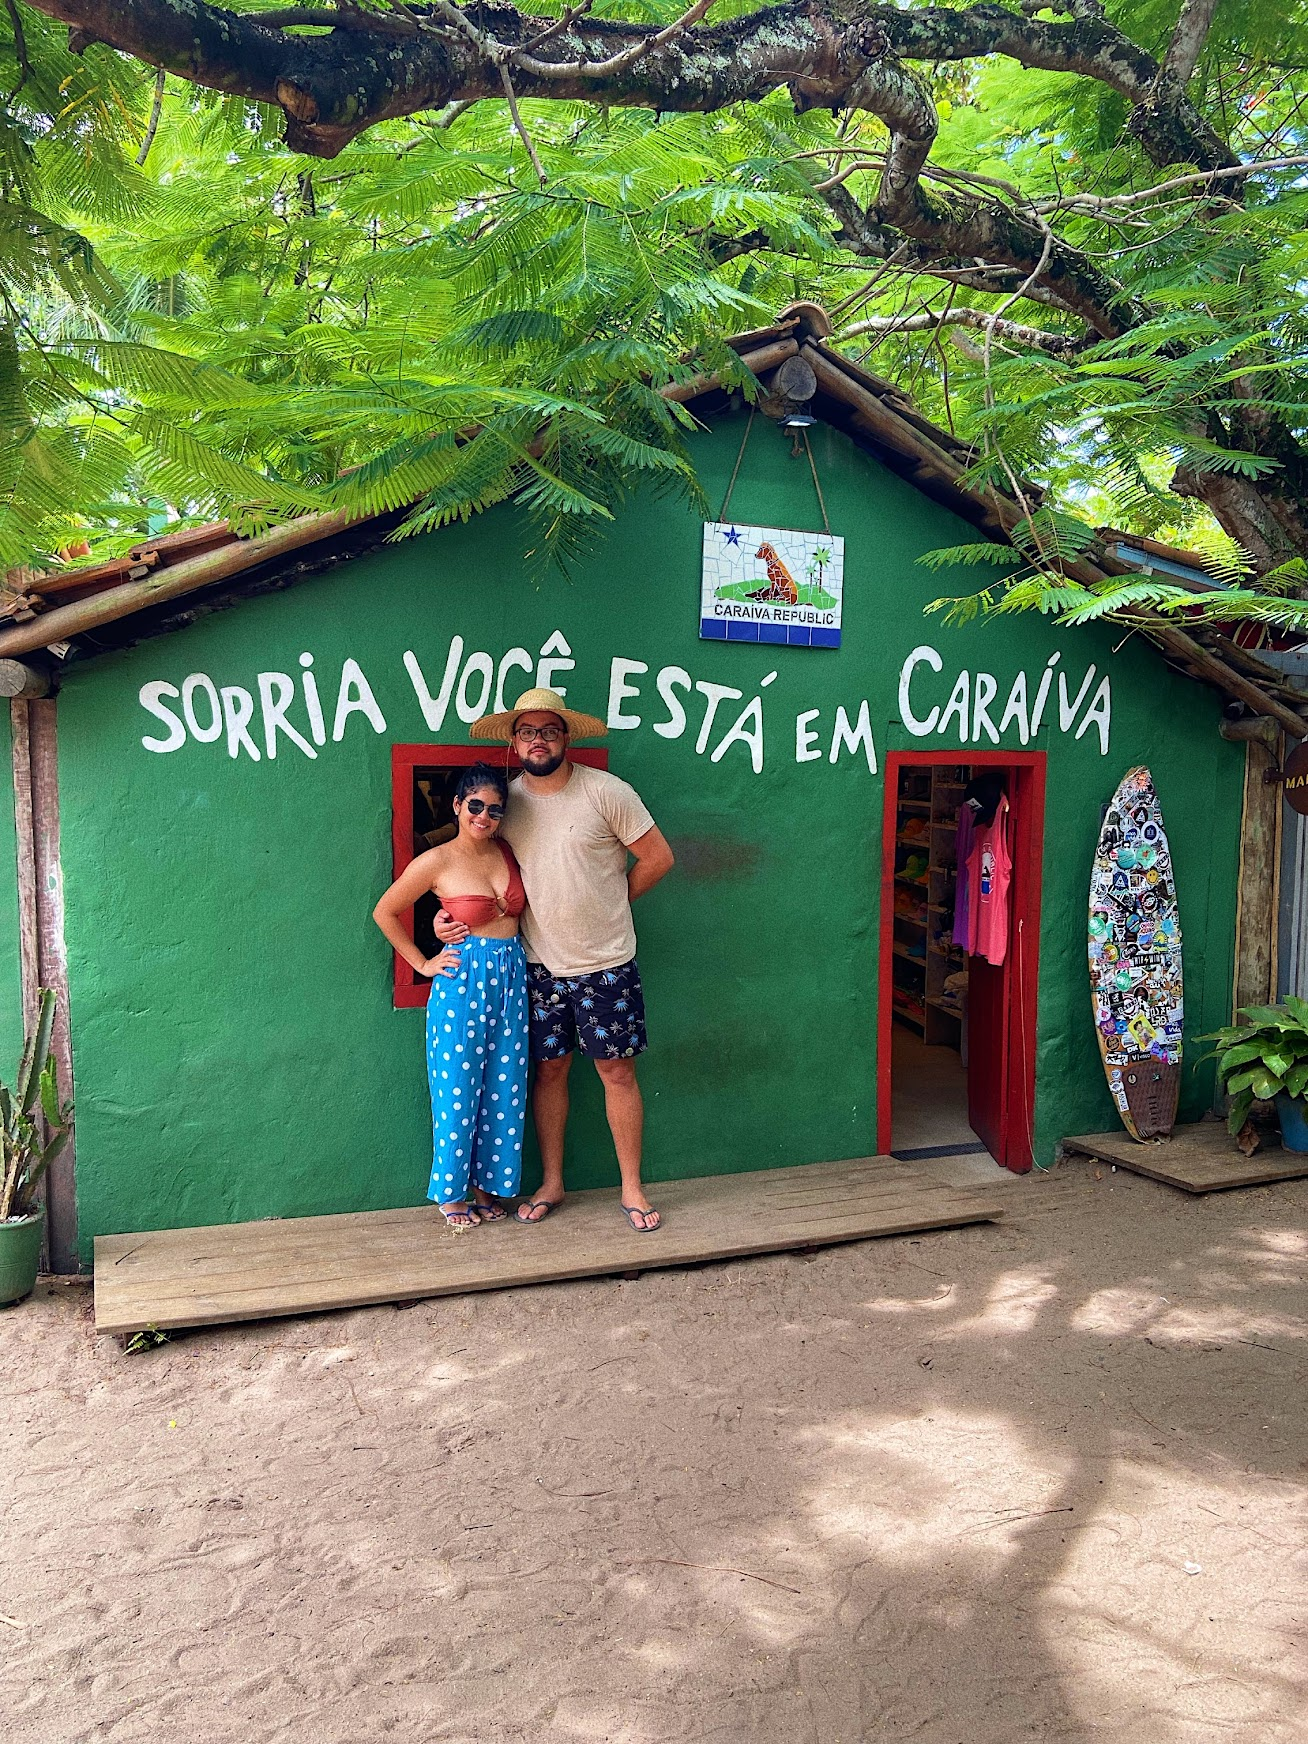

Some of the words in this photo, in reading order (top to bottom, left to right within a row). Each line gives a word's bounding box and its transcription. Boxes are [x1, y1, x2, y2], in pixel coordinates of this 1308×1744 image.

[403, 629, 576, 732] VOCÊ
[606, 656, 779, 774] ESTÁ
[796, 699, 878, 775] EM
[899, 645, 1111, 756] CARAÍVA
